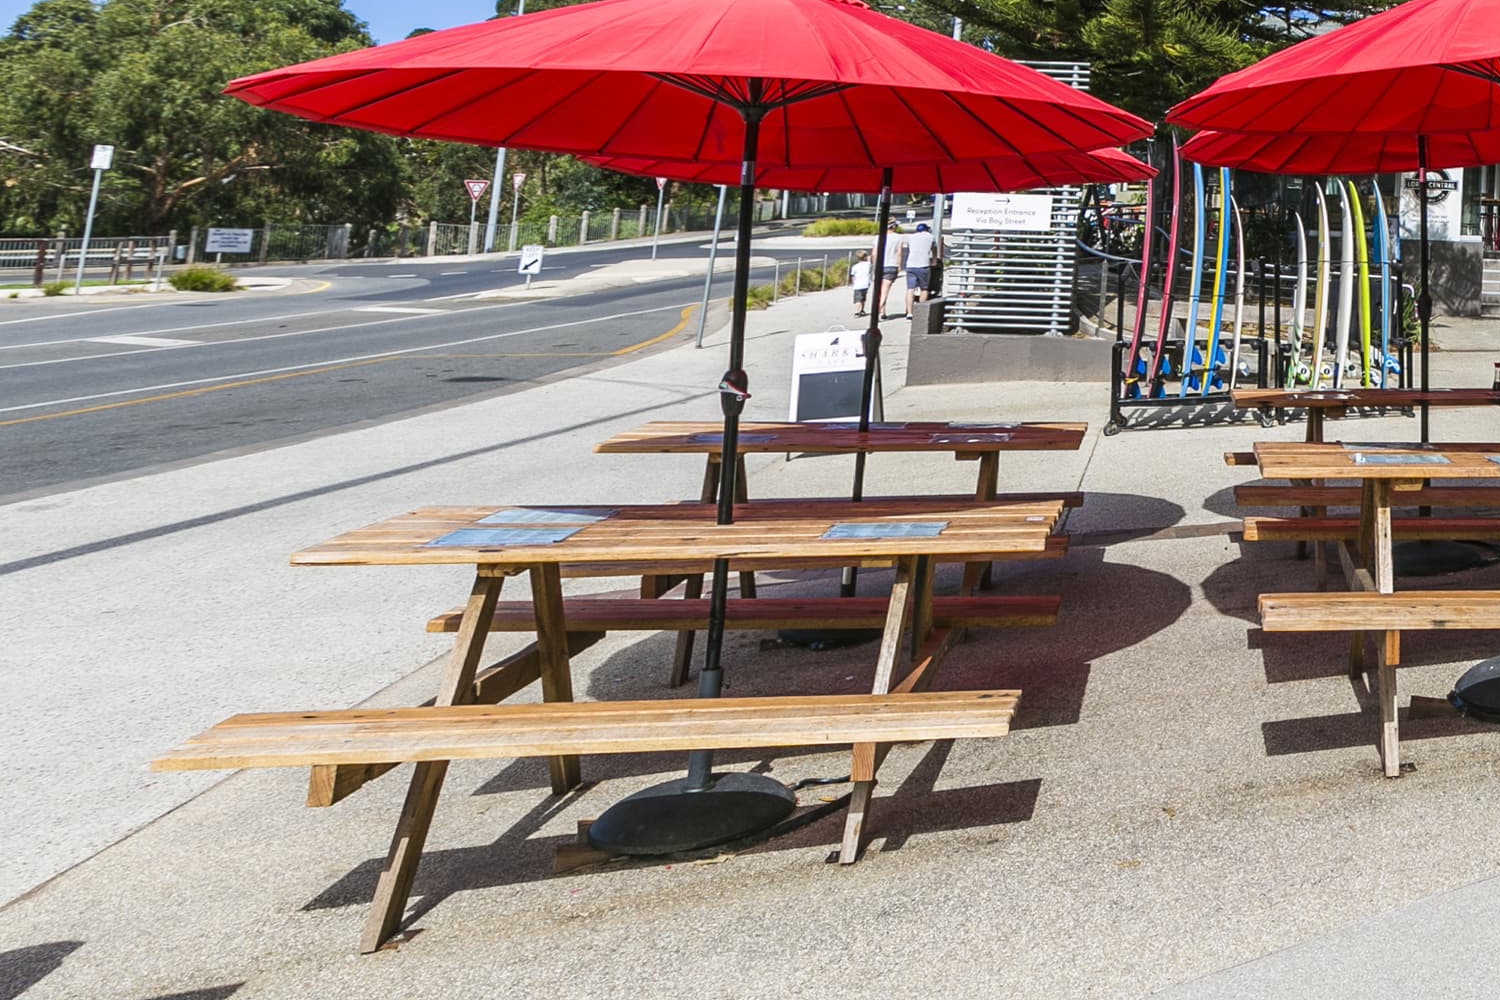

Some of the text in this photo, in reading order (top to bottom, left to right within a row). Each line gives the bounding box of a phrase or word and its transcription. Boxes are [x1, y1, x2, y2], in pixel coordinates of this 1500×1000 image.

[1428, 181, 1456, 189] CENTRAL
[967, 207, 1036, 216] Reception Entrance
[1005, 217, 1026, 225] Street
